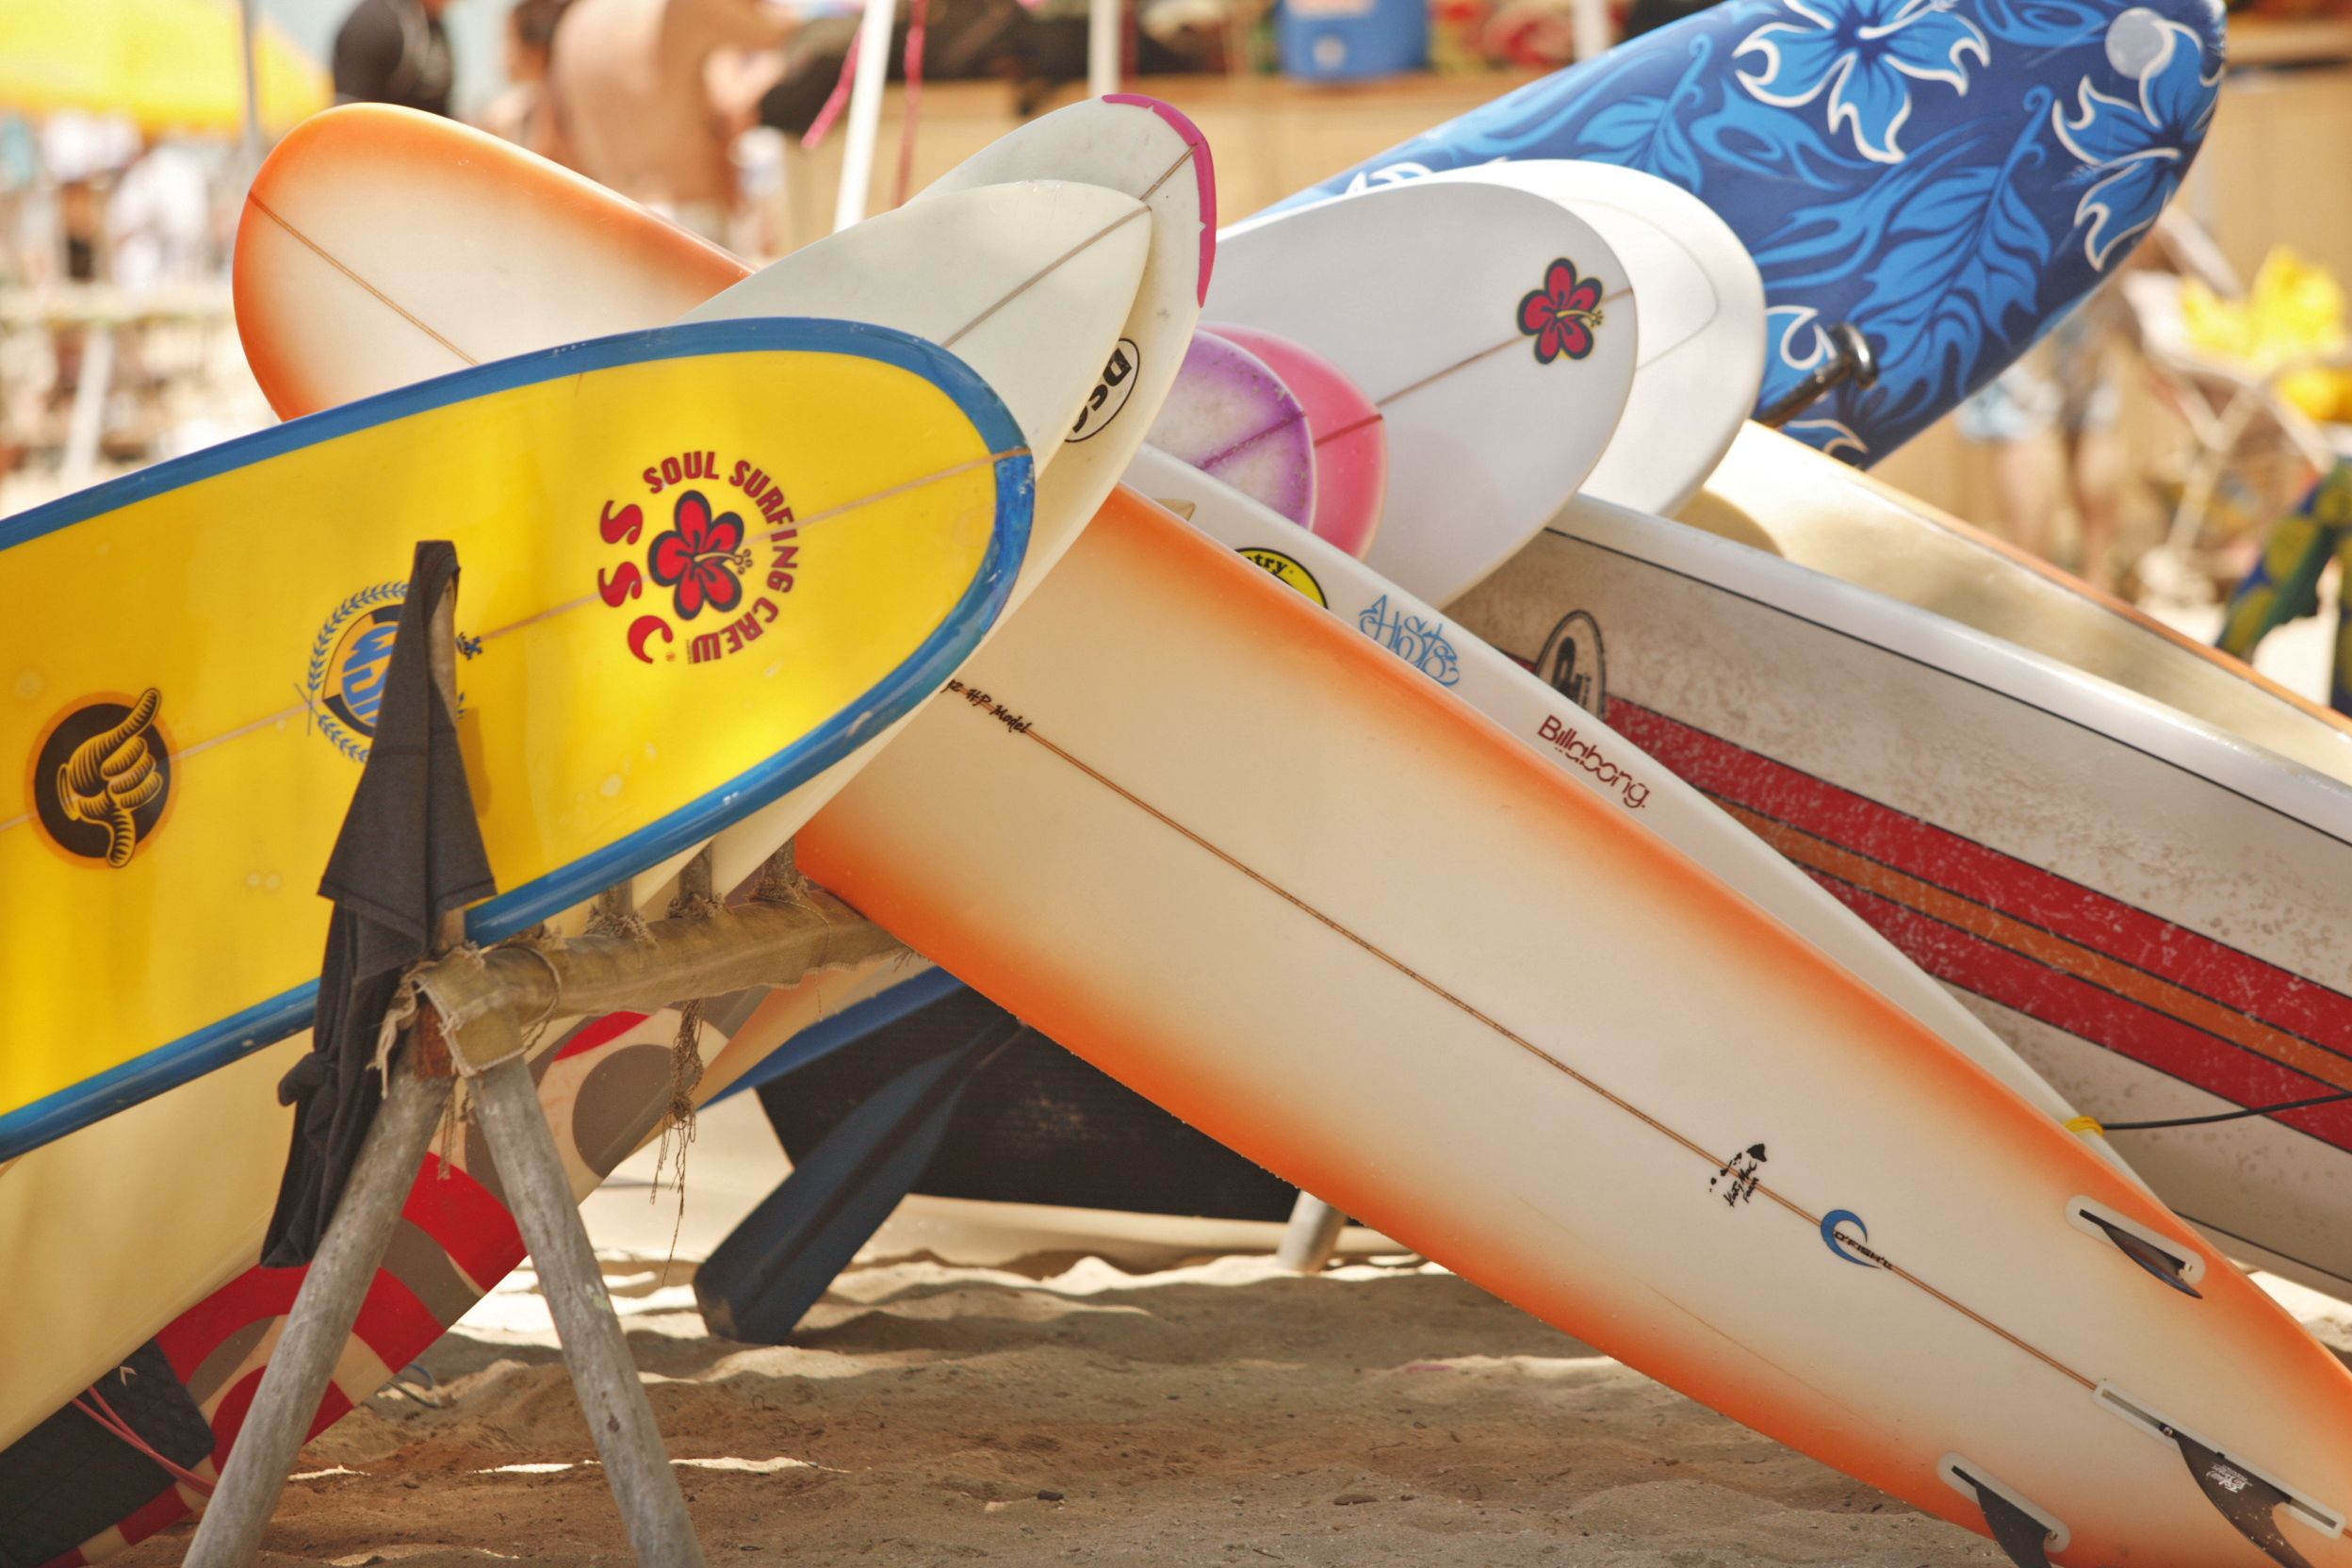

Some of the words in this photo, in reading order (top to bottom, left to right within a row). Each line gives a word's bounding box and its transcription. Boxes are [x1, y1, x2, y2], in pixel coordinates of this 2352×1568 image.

[643, 450, 719, 494] SOUL
[728, 460, 799, 594] SURFING
[691, 596, 779, 663] CREW
[989, 705, 1033, 733] Model
